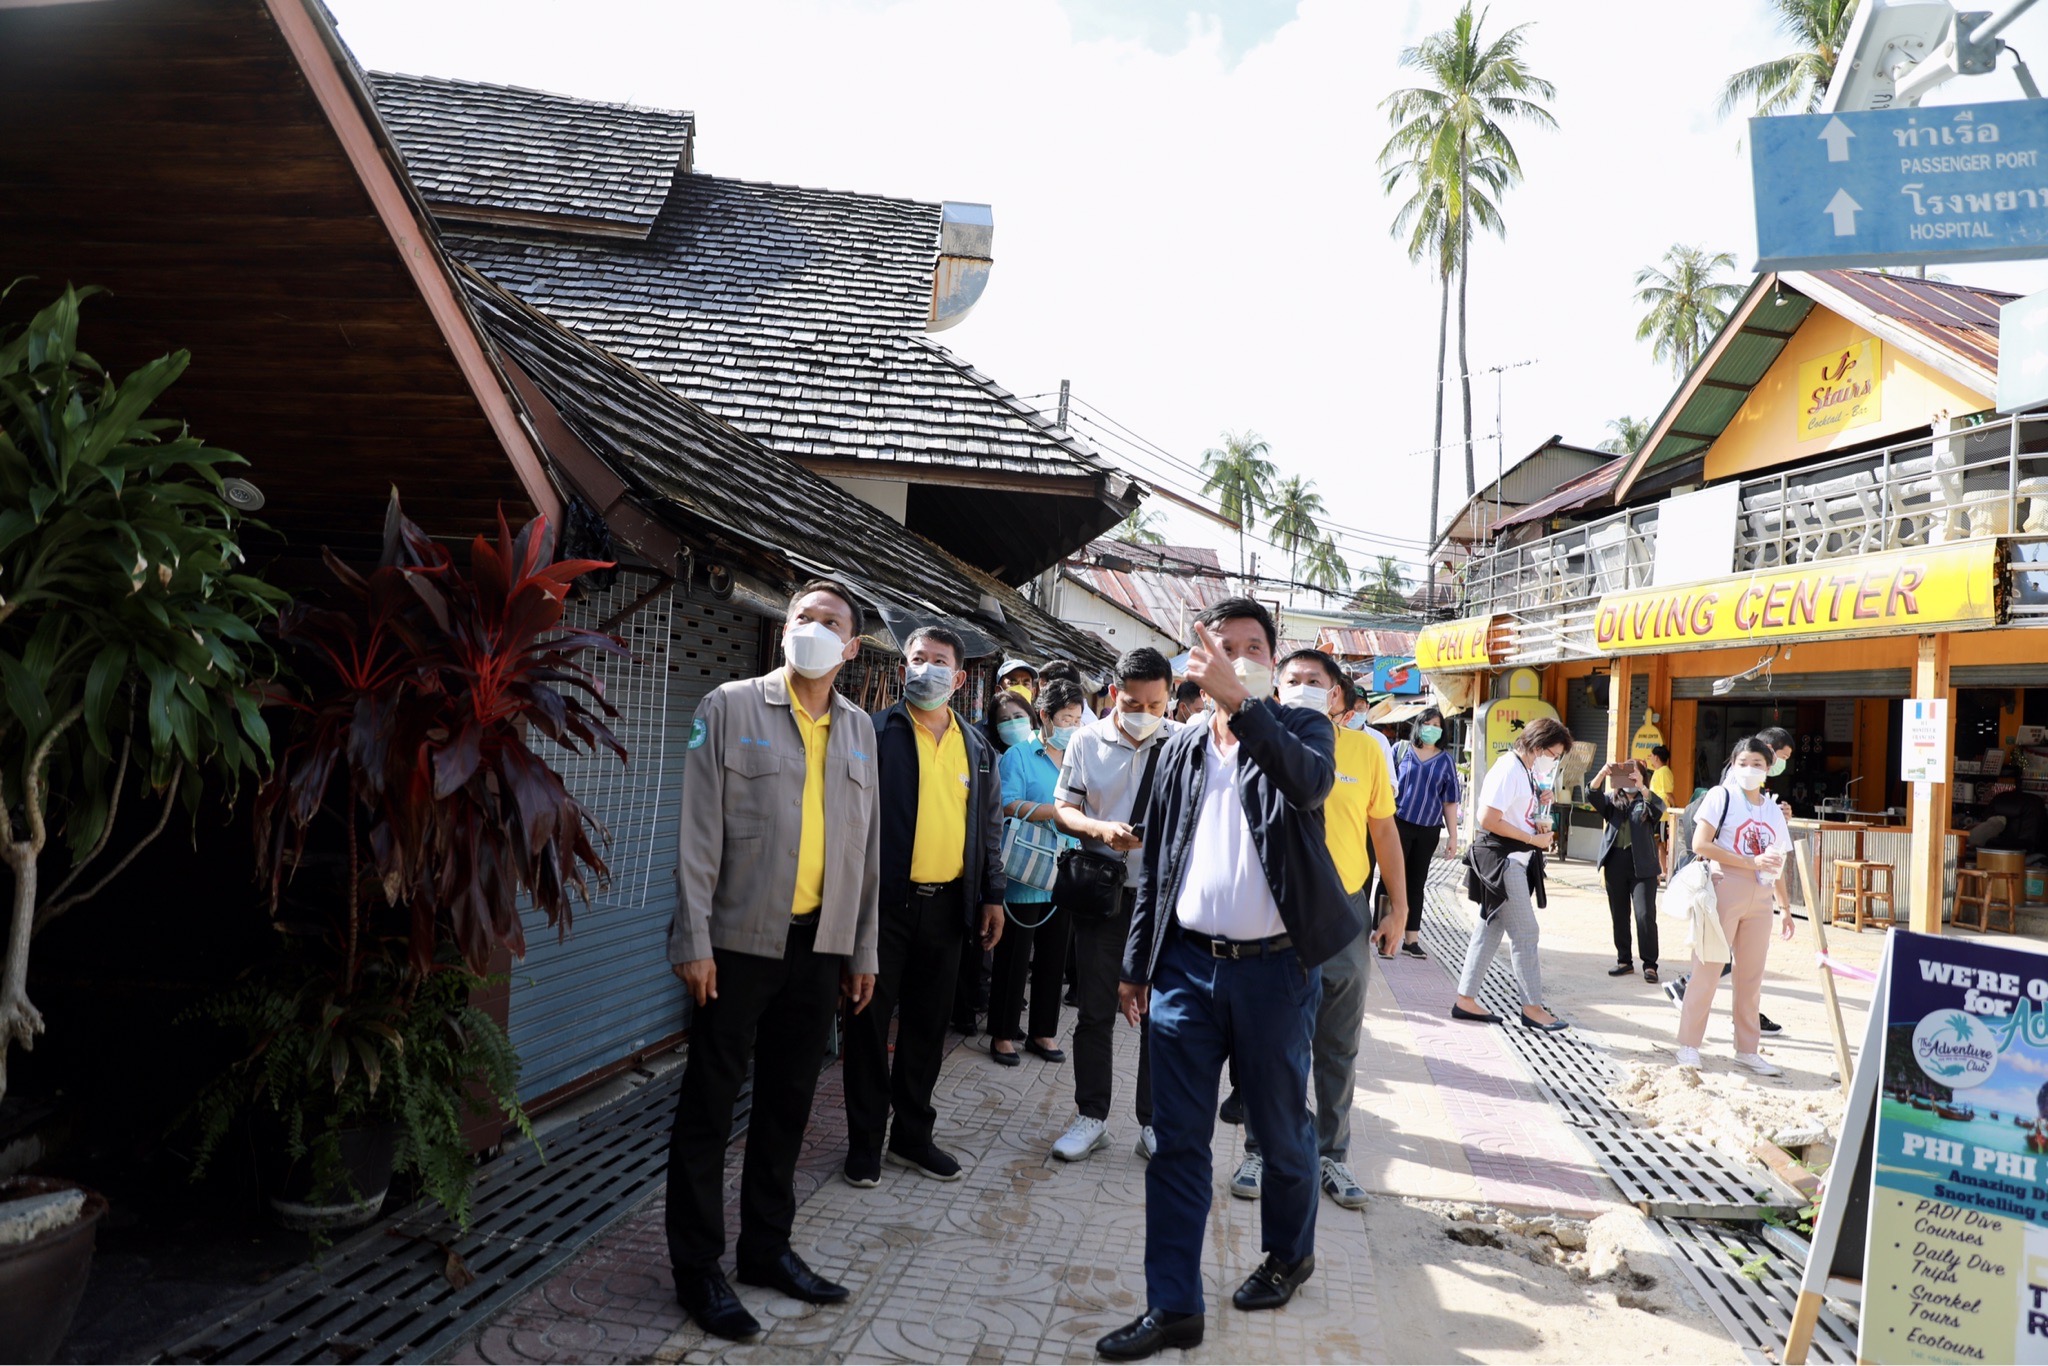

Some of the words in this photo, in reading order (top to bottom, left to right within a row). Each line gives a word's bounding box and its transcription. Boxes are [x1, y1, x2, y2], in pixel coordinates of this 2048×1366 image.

[1893, 111, 1999, 147] ท่าเรือ
[1901, 155, 1991, 174] PASSENGER
[1996, 150, 2038, 170] PORT
[1910, 221, 1993, 240] HOSPITAL
[1807, 378, 1871, 415] Stairs
[1807, 411, 1842, 430] Cocktail
[1598, 592, 1719, 643] DIVING
[1735, 563, 1928, 630] CENTER
[1437, 629, 1465, 661] PHI
[1492, 741, 1515, 749] DIVIN
[1919, 958, 2020, 997] WE'RE
[1964, 988, 2012, 1017] for
[1919, 1040, 1993, 1059] Adventure
[1966, 1059, 1988, 1072] Club
[1902, 1132, 1964, 1166] PHI
[1972, 1146, 2038, 1182] PHI
[1948, 1170, 2027, 1200] Amazing
[1915, 1200, 1962, 1222] PADI
[1964, 1210, 2003, 1232] Dive
[1934, 1184, 2036, 1220] Snorkelling
[1914, 1217, 1984, 1247] Courses
[1912, 1241, 1962, 1271] Daily
[1967, 1254, 2006, 1276] Dive
[1912, 1259, 1958, 1284] Trips
[1909, 1284, 1982, 1314] Snorkel
[1909, 1302, 1961, 1328] Tours
[1907, 1327, 1985, 1360] Ecotours
